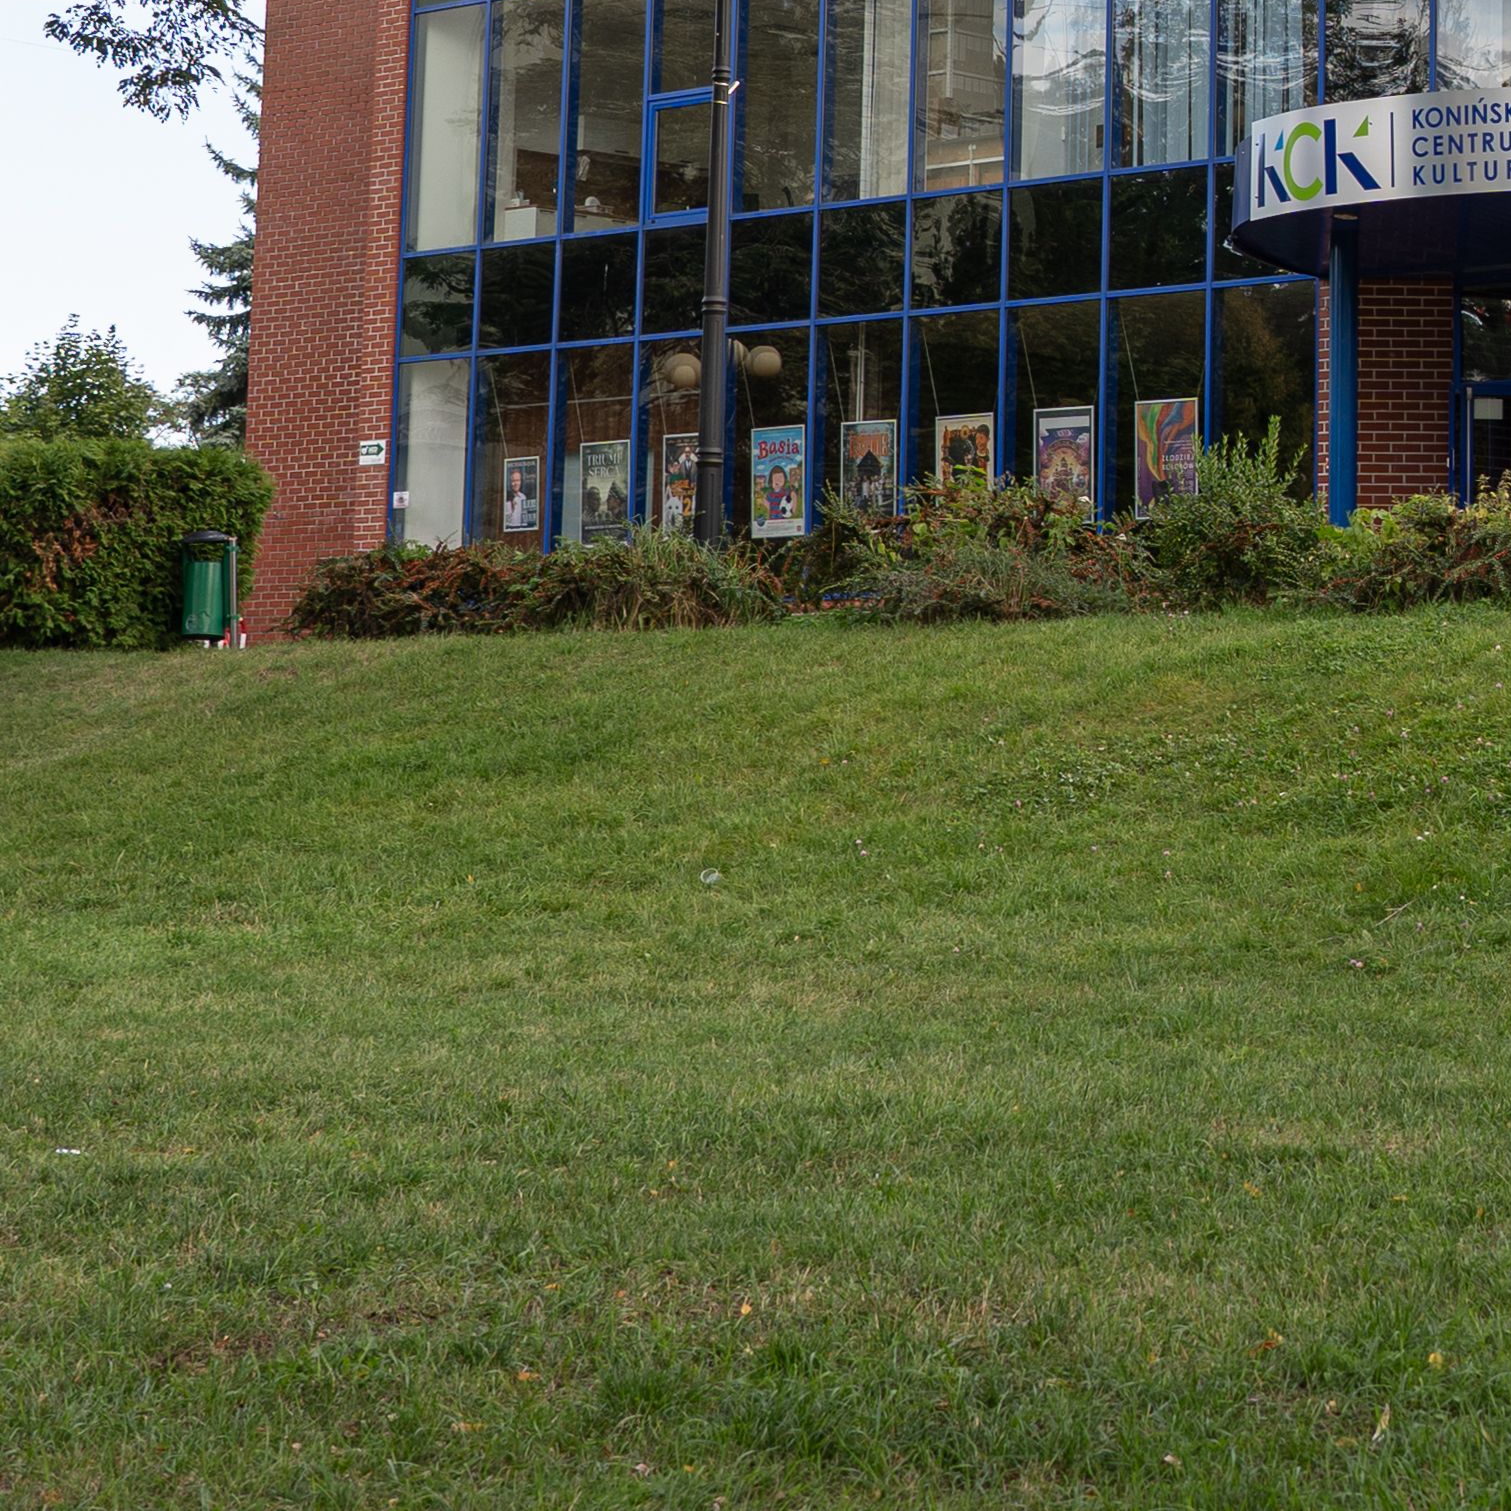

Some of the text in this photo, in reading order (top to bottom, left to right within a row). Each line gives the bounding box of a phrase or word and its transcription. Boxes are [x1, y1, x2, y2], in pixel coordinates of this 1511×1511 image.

[1257, 115, 1382, 208] KCK
[757, 439, 800, 459] Basia
[683, 498, 692, 516] 2
